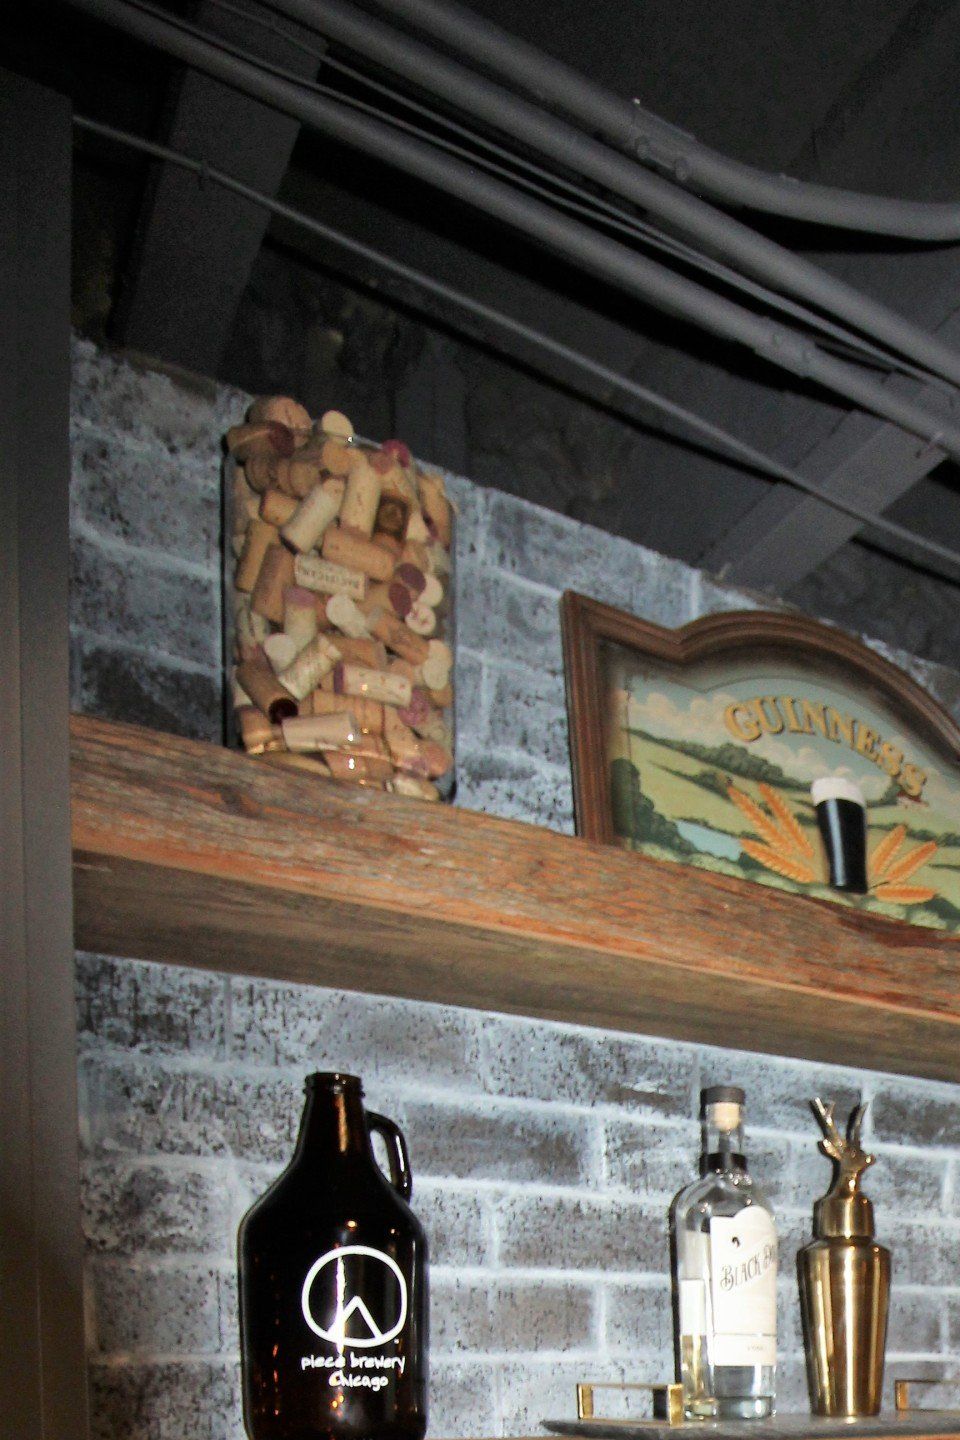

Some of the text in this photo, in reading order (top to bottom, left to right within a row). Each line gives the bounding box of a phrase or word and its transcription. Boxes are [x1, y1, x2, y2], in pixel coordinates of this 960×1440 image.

[724, 696, 927, 797] GUINNESS
[301, 1351, 406, 1374] piece brewery
[328, 1369, 389, 1392] Chicago
